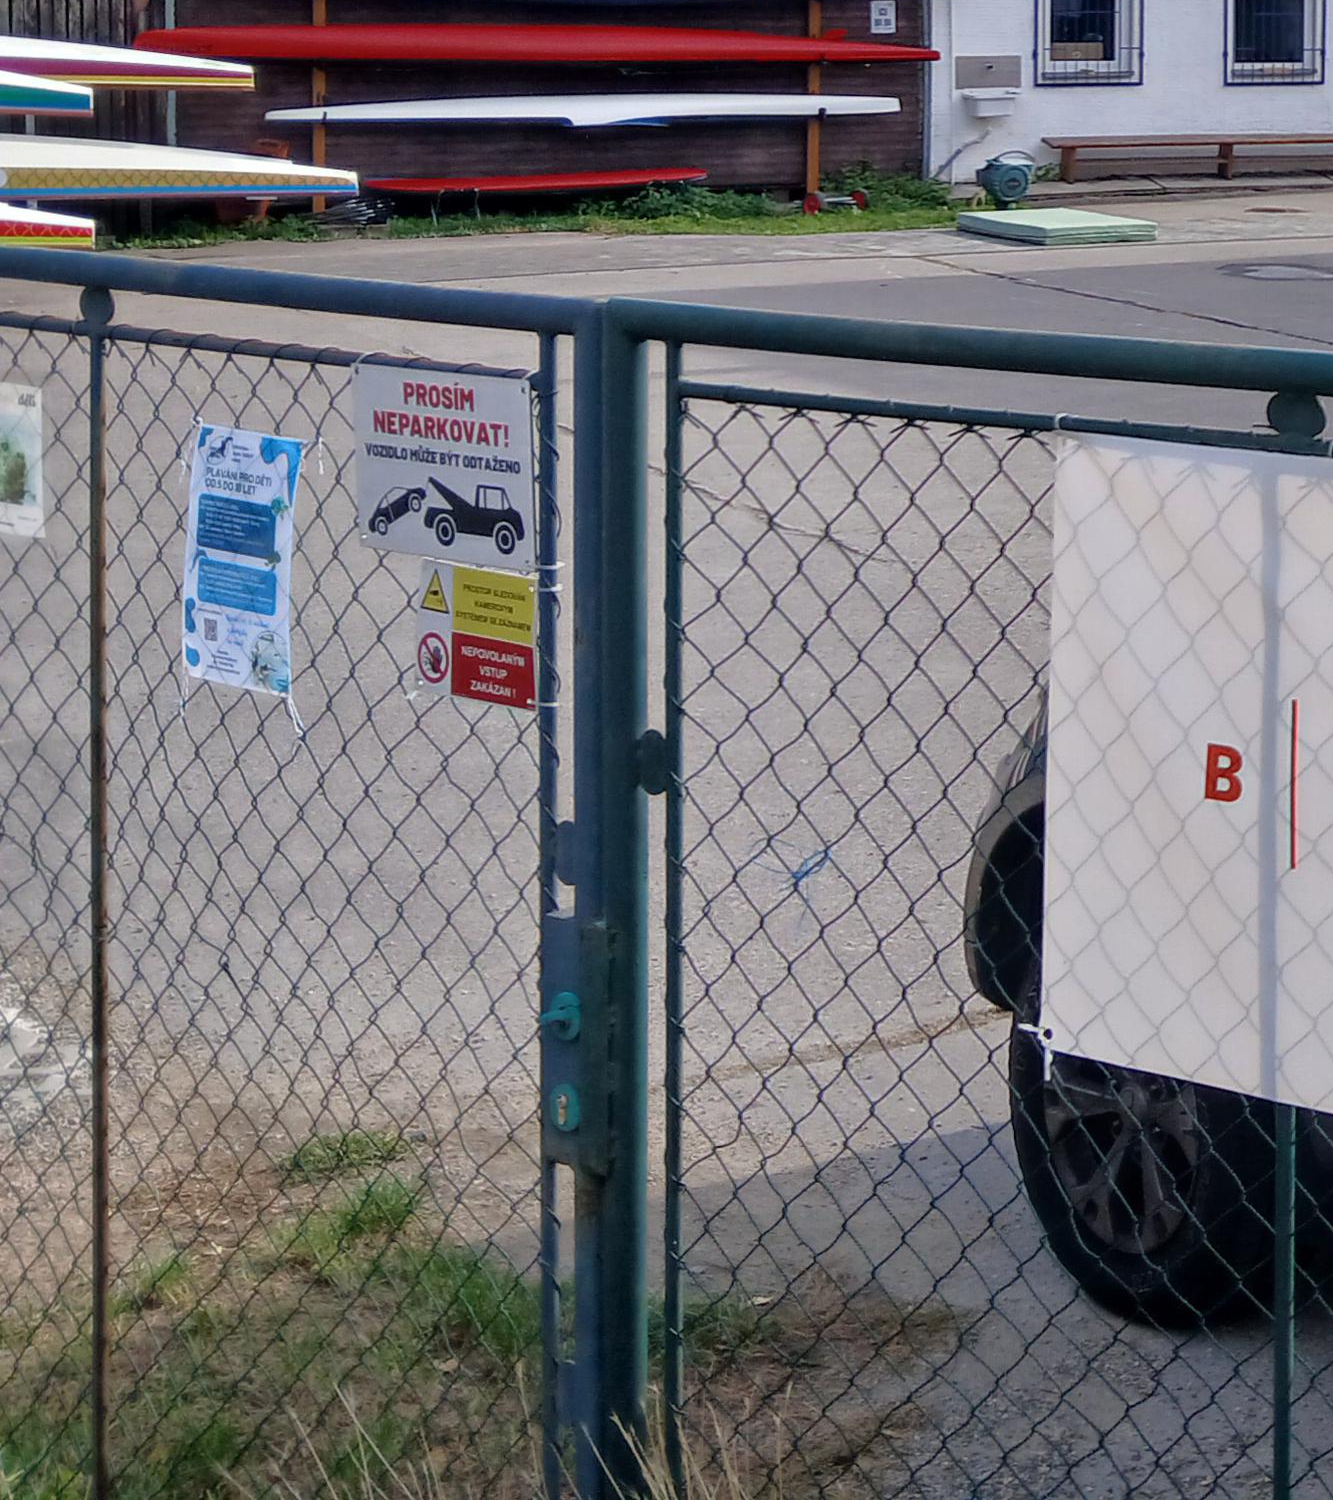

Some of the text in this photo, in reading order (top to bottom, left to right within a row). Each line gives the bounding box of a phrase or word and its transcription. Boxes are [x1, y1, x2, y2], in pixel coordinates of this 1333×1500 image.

[403, 381, 475, 412] PROSÍM
[373, 409, 510, 448] NEPARKOVAT!
[364, 442, 522, 475] VOZIDLO MŮŽE BÝT ODTAŽENO
[479, 664, 509, 679] VSTUP
